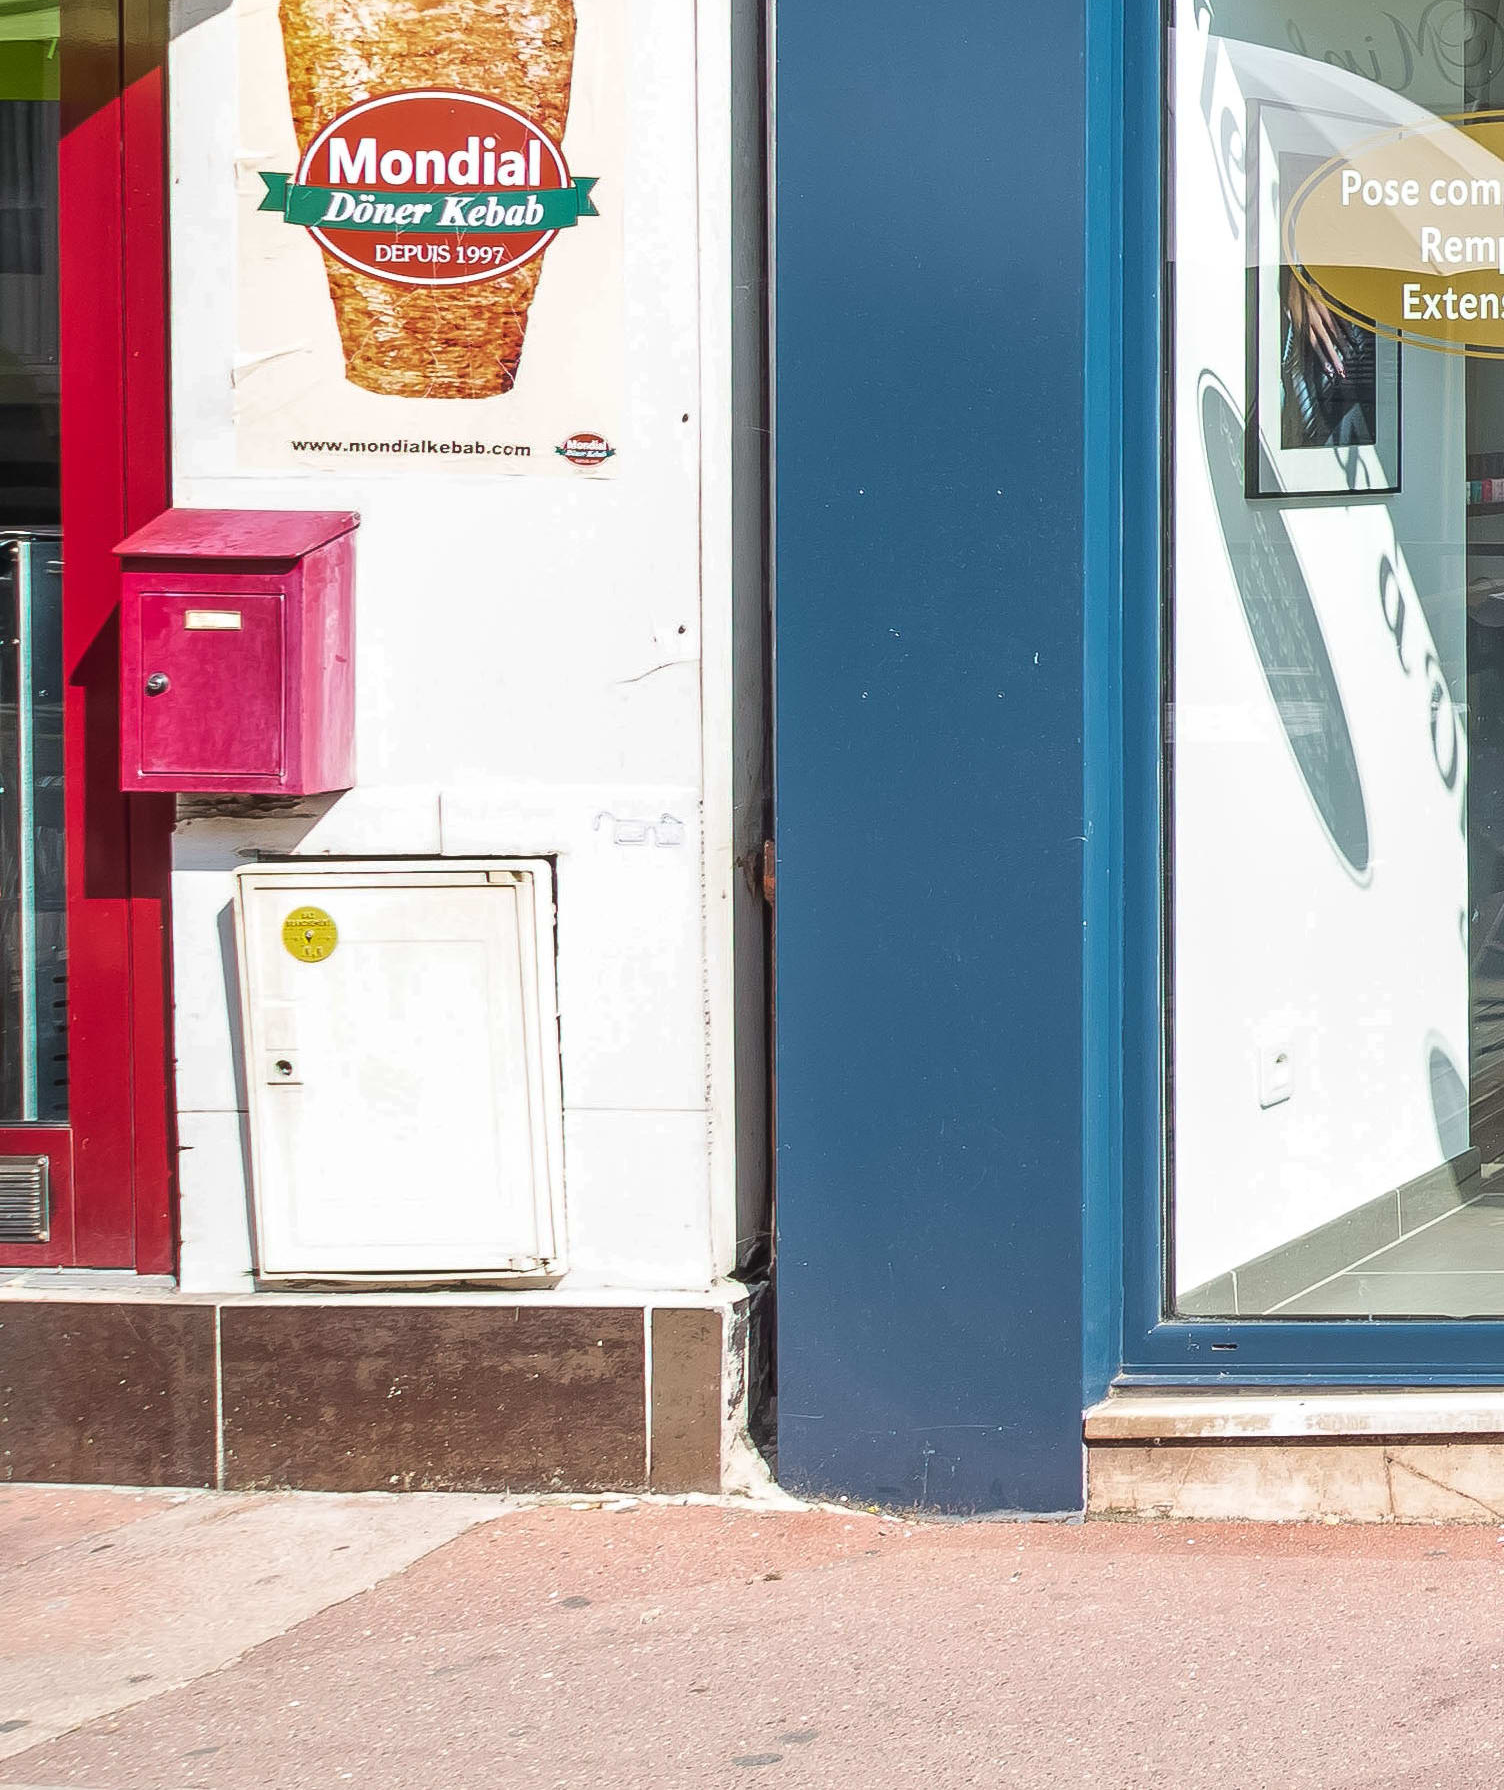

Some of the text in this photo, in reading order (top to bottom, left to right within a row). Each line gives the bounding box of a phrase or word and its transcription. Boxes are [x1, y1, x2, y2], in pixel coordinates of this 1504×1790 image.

[328, 136, 542, 187] Mondial
[1342, 169, 1419, 206] Pose
[321, 191, 545, 228] Döner Kebab
[375, 244, 505, 265] DEPUIS 1997
[291, 440, 531, 456] www.mondialkebab.com
